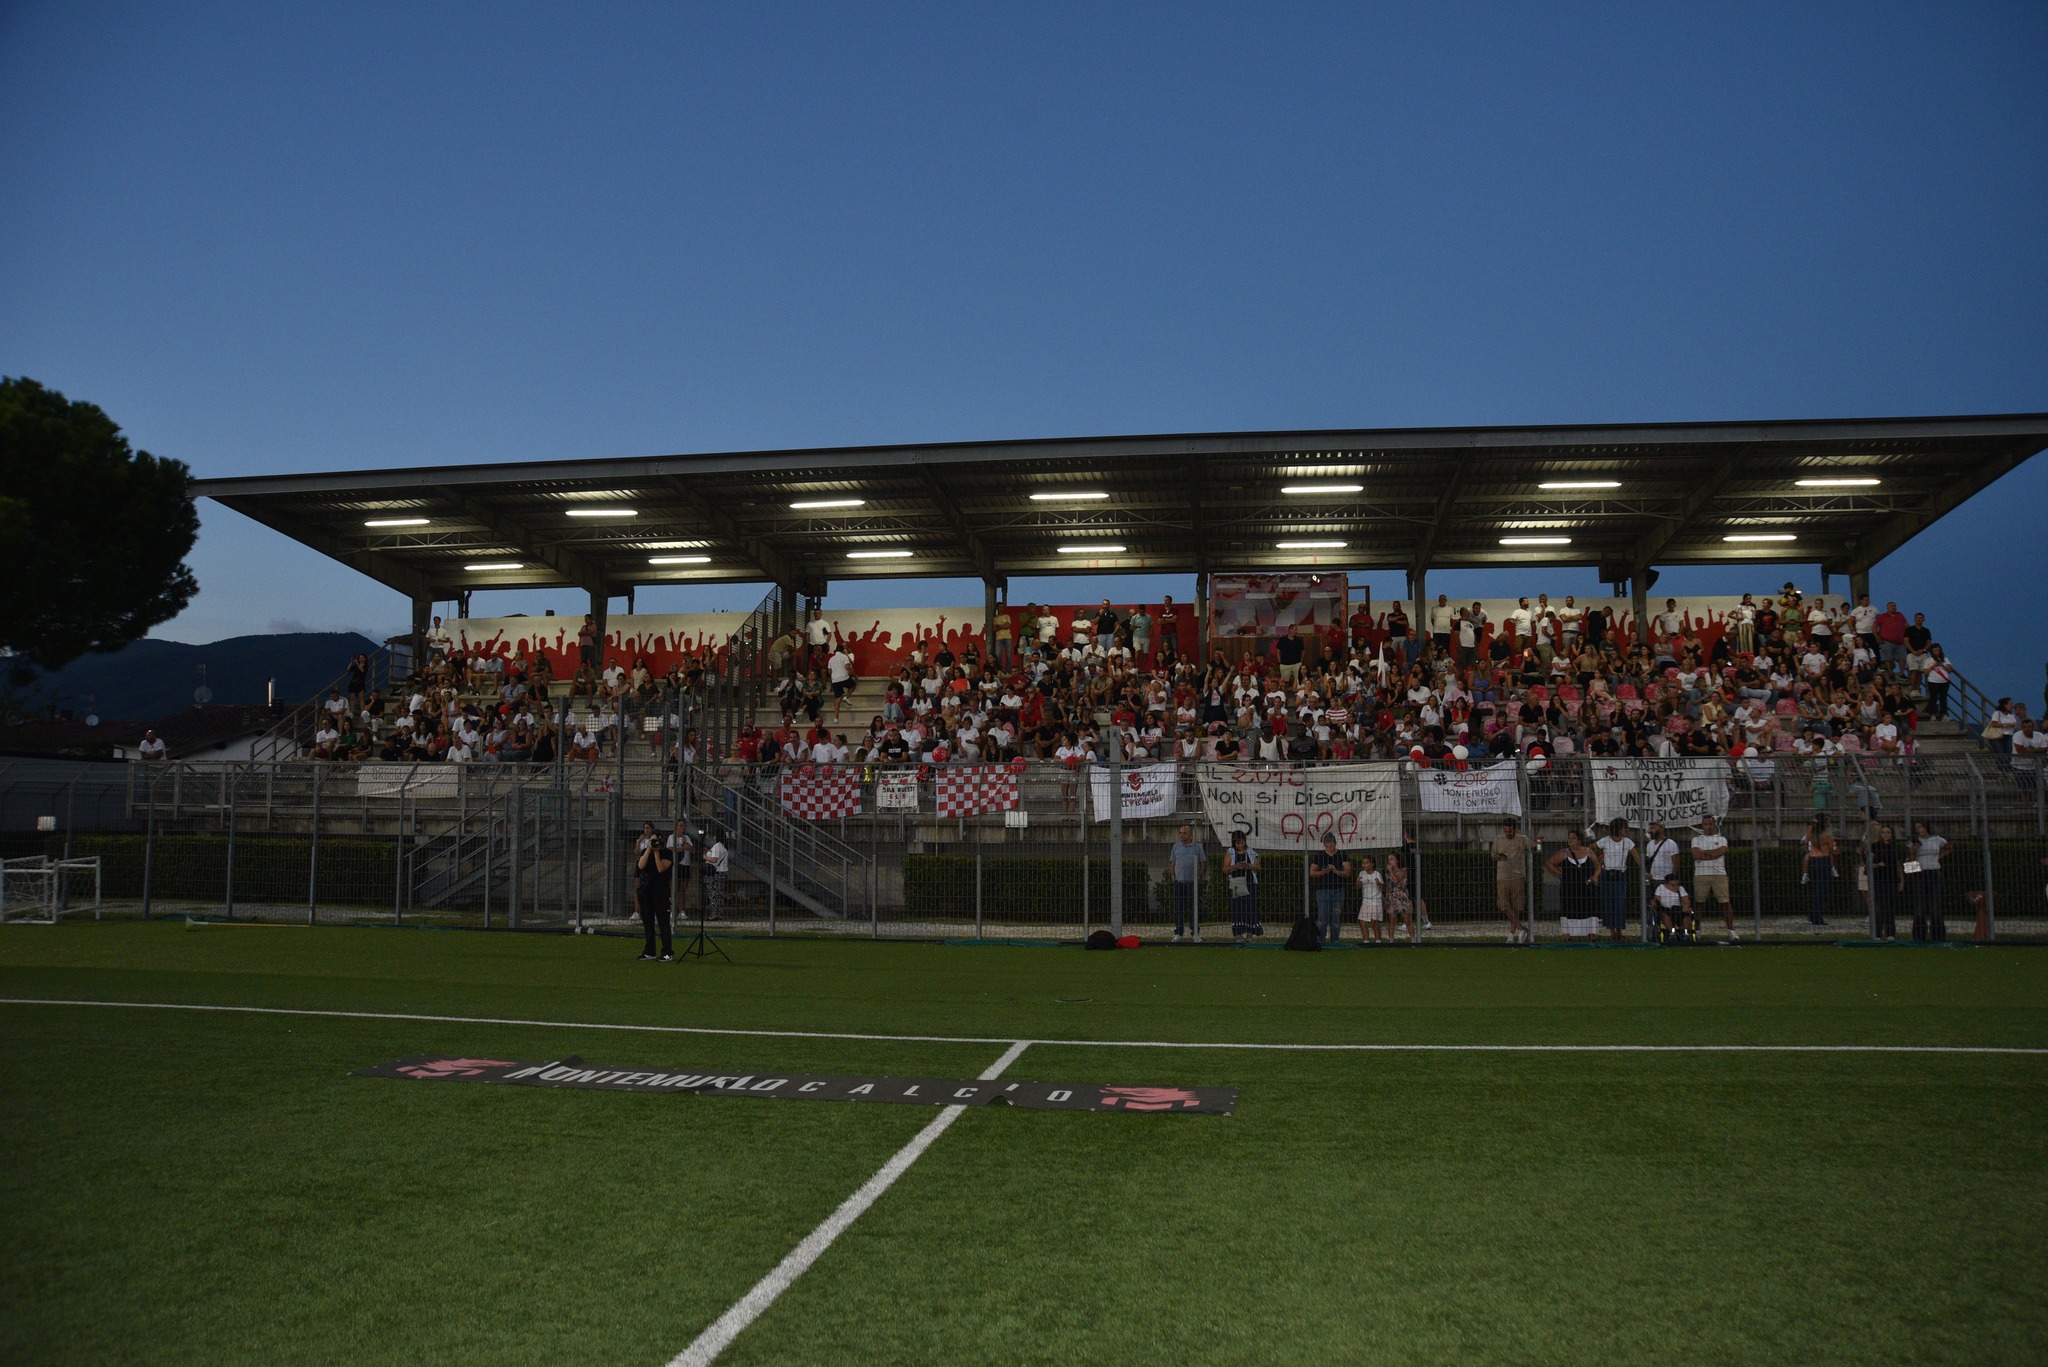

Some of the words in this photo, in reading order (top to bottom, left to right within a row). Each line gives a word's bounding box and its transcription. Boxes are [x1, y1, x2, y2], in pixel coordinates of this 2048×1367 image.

[1206, 766, 1222, 781] IL
[1453, 771, 1489, 787] 2018
[1642, 773, 1684, 791] 2017
[1208, 787, 1244, 805] NON
[1442, 787, 1501, 798] MONTEMURLO
[1668, 787, 1706, 805] VINCE
[1465, 799, 1477, 807] ON
[1480, 797, 1498, 805] FIRE
[1668, 802, 1709, 820] CRESCE
